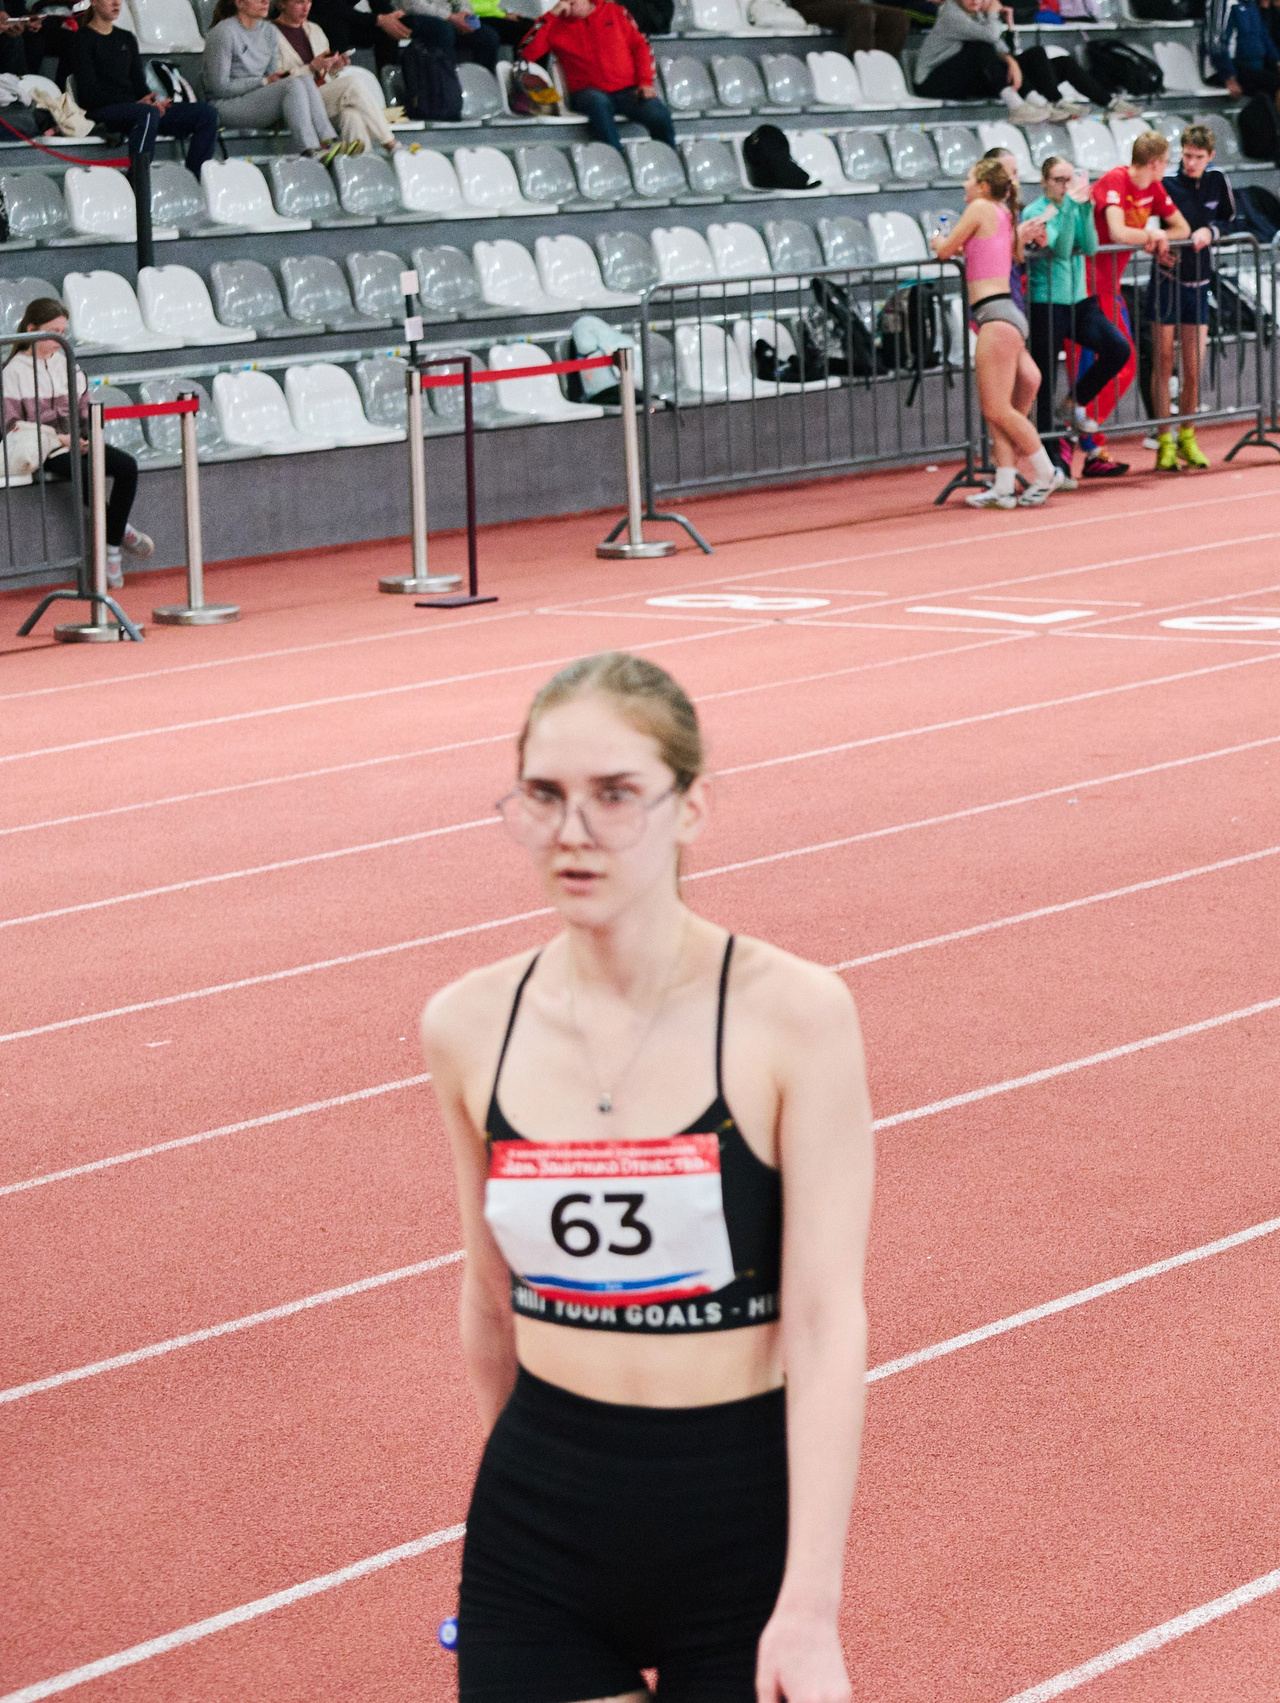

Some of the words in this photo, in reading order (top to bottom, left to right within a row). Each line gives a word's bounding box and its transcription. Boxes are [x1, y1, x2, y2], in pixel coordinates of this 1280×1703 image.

[645, 592, 832, 611] 8
[904, 605, 1097, 625] 7
[550, 1192, 653, 1258] 63
[624, 1302, 723, 1327] GOALS
